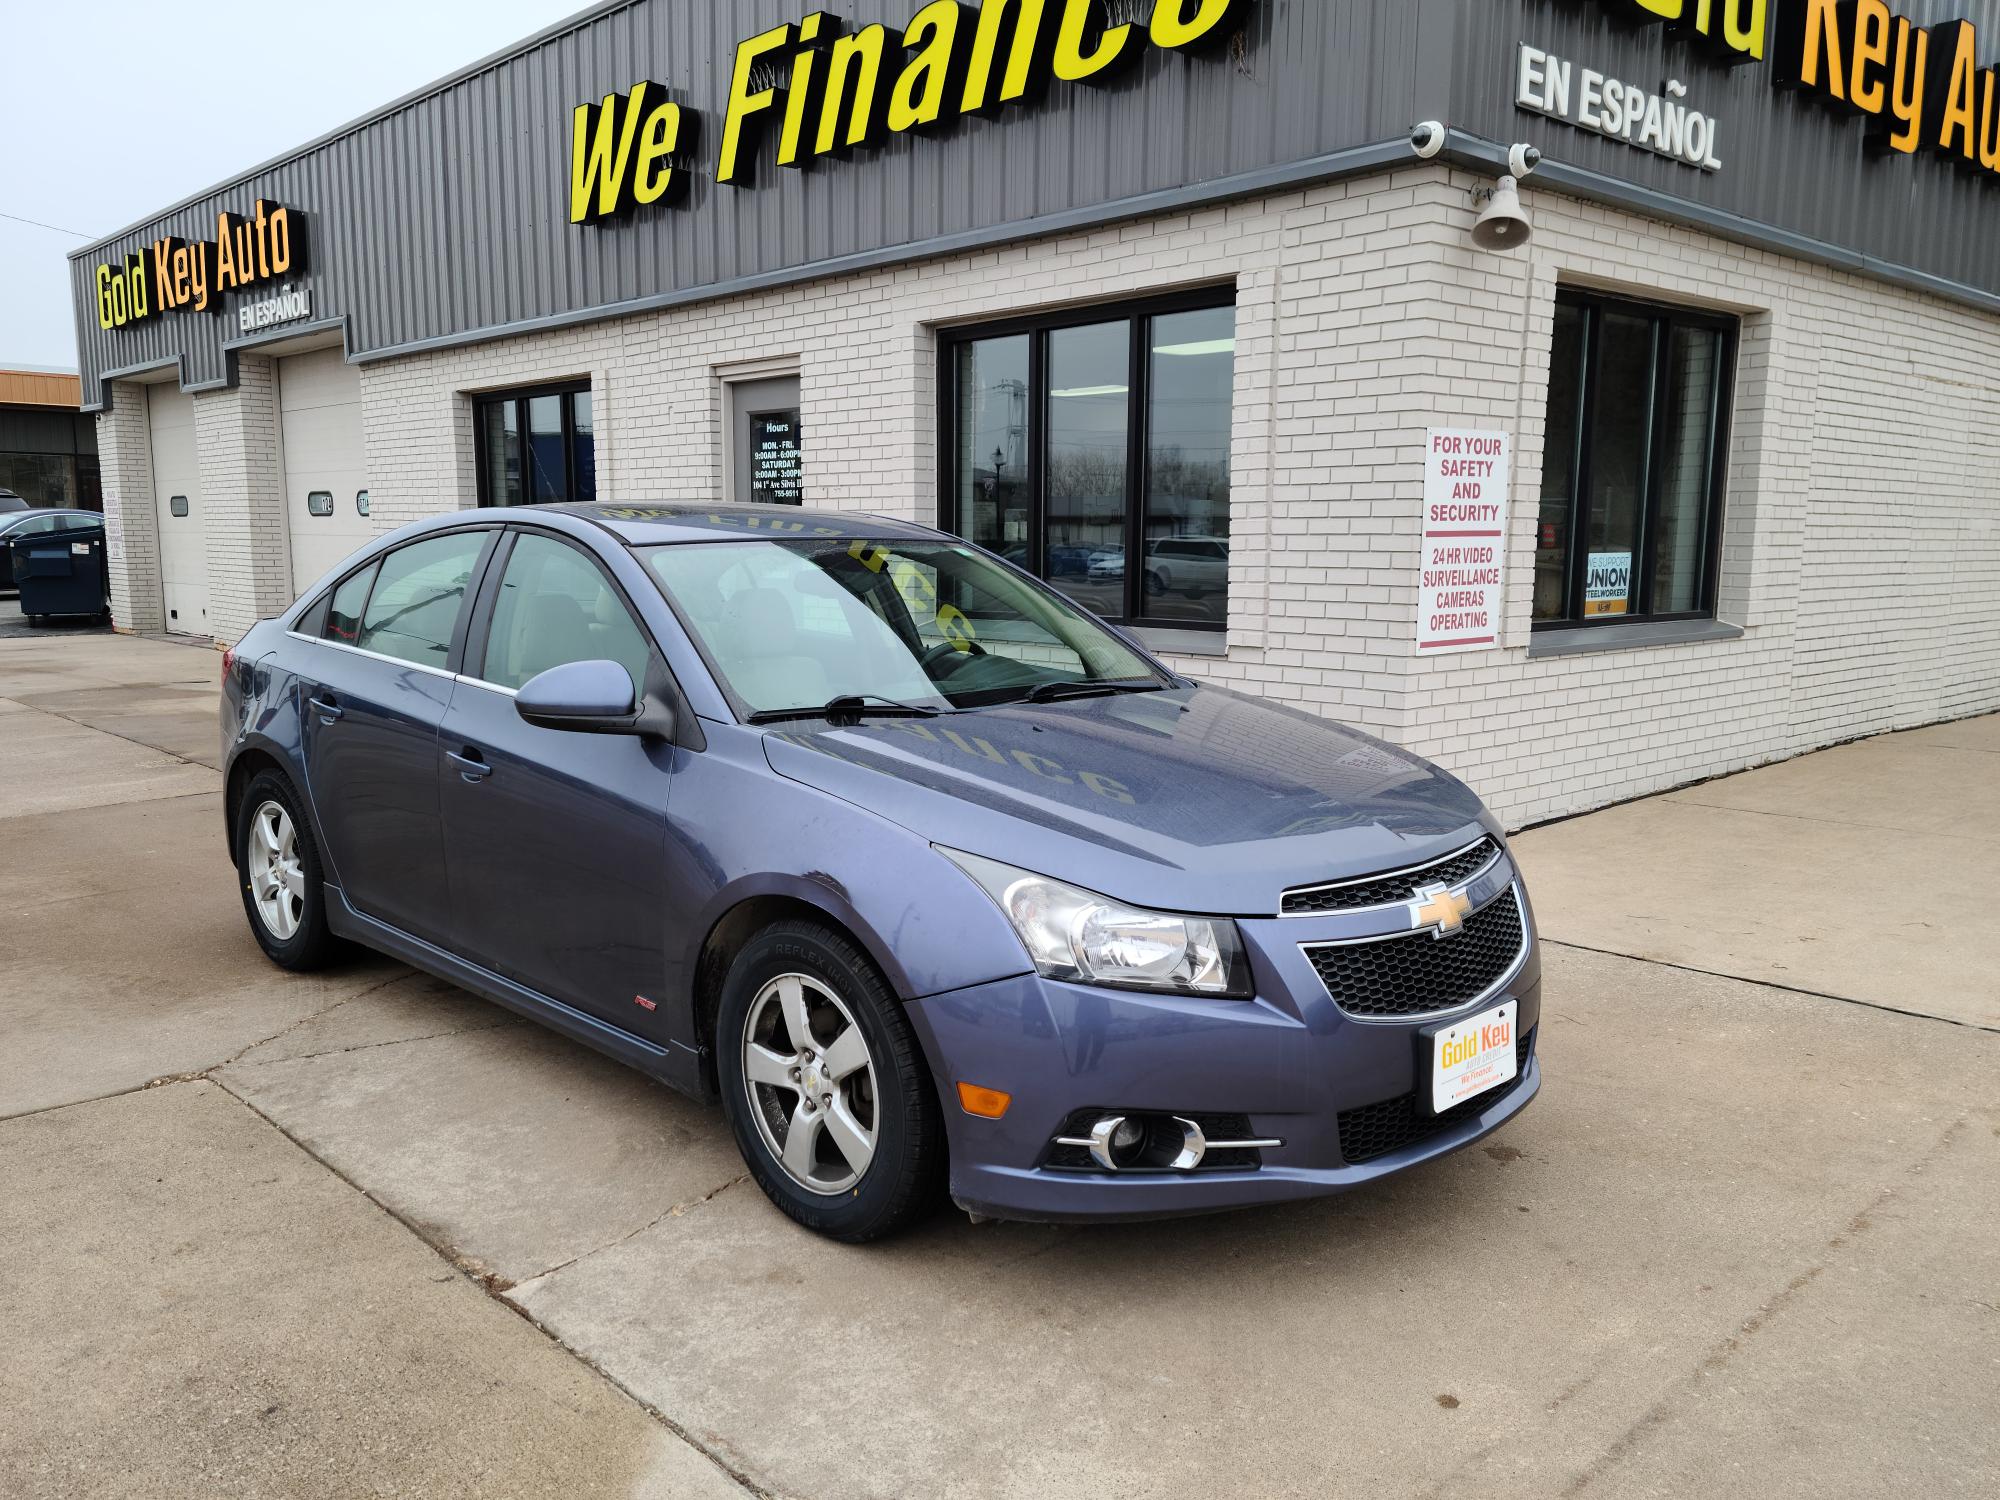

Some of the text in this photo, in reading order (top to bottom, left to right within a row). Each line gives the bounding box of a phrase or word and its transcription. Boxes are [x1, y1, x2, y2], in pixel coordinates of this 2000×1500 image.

[1518, 45, 1722, 171] EN ESPAÑOL
[570, 80, 680, 225] We
[96, 198, 290, 331] Gold Key Auto
[239, 283, 310, 331] EN ESPAÑOL
[766, 423, 789, 432] Hours
[1433, 435, 1502, 455] FOR YOUR
[762, 460, 795, 468] SATURDAY
[1440, 459, 1494, 477] SAFETY
[1452, 482, 1481, 500] AND
[1430, 504, 1499, 522] SECURITY
[1432, 546, 1493, 566] 24 HR VIDEO
[1598, 556, 1630, 567] SUPPORT
[1423, 568, 1499, 588] SURVEILLANCE
[1436, 590, 1485, 609] CAMERAS
[1586, 588, 1627, 599] TEELWORKERS
[1430, 610, 1488, 632] OPERATING
[1442, 1031, 1477, 1069] Gold
[1482, 1023, 1510, 1051] Key
